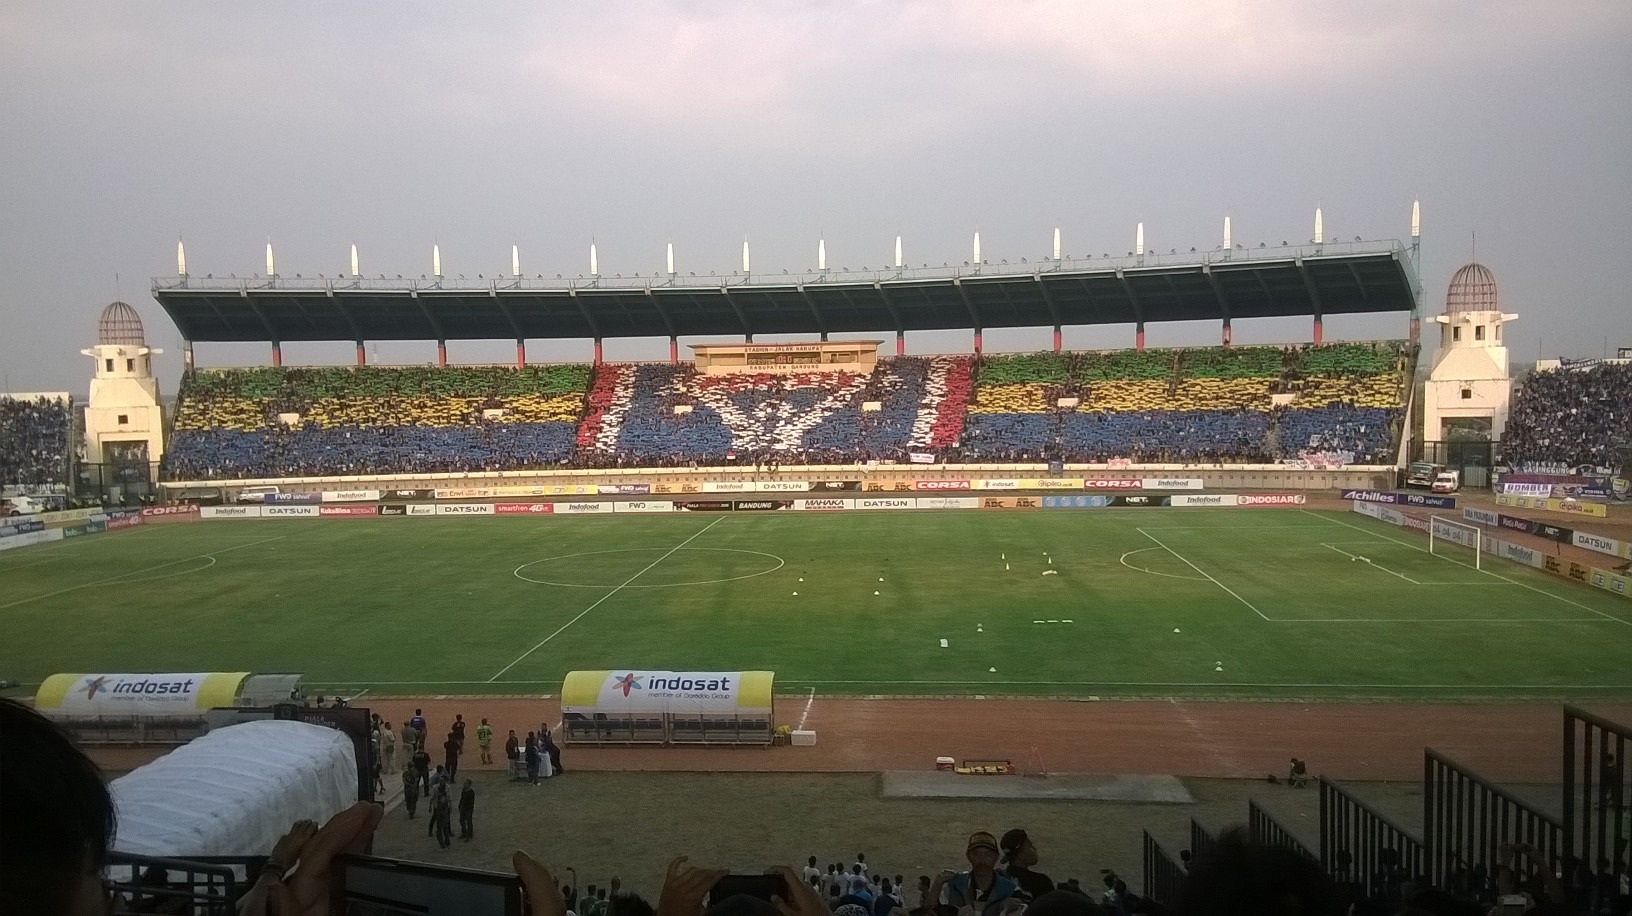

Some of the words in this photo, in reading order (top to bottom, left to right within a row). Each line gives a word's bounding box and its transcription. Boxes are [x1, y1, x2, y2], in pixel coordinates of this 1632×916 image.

[917, 481, 970, 489] CORSA
[1085, 480, 1141, 488] CORSA
[336, 491, 367, 499] Indofood
[1344, 490, 1395, 502] Achilles
[1186, 496, 1221, 504] Indofood
[1248, 496, 1295, 504] INDOSIAR
[1407, 495, 1425, 504] FWD
[142, 504, 198, 516] CORSA
[498, 504, 528, 512] smartfren
[568, 503, 599, 511] Indofood
[215, 507, 247, 516] Indofood
[1578, 534, 1613, 551] DATSUN
[113, 679, 194, 694] indosat
[648, 676, 730, 691] indosat
[711, 692, 730, 700] Group
